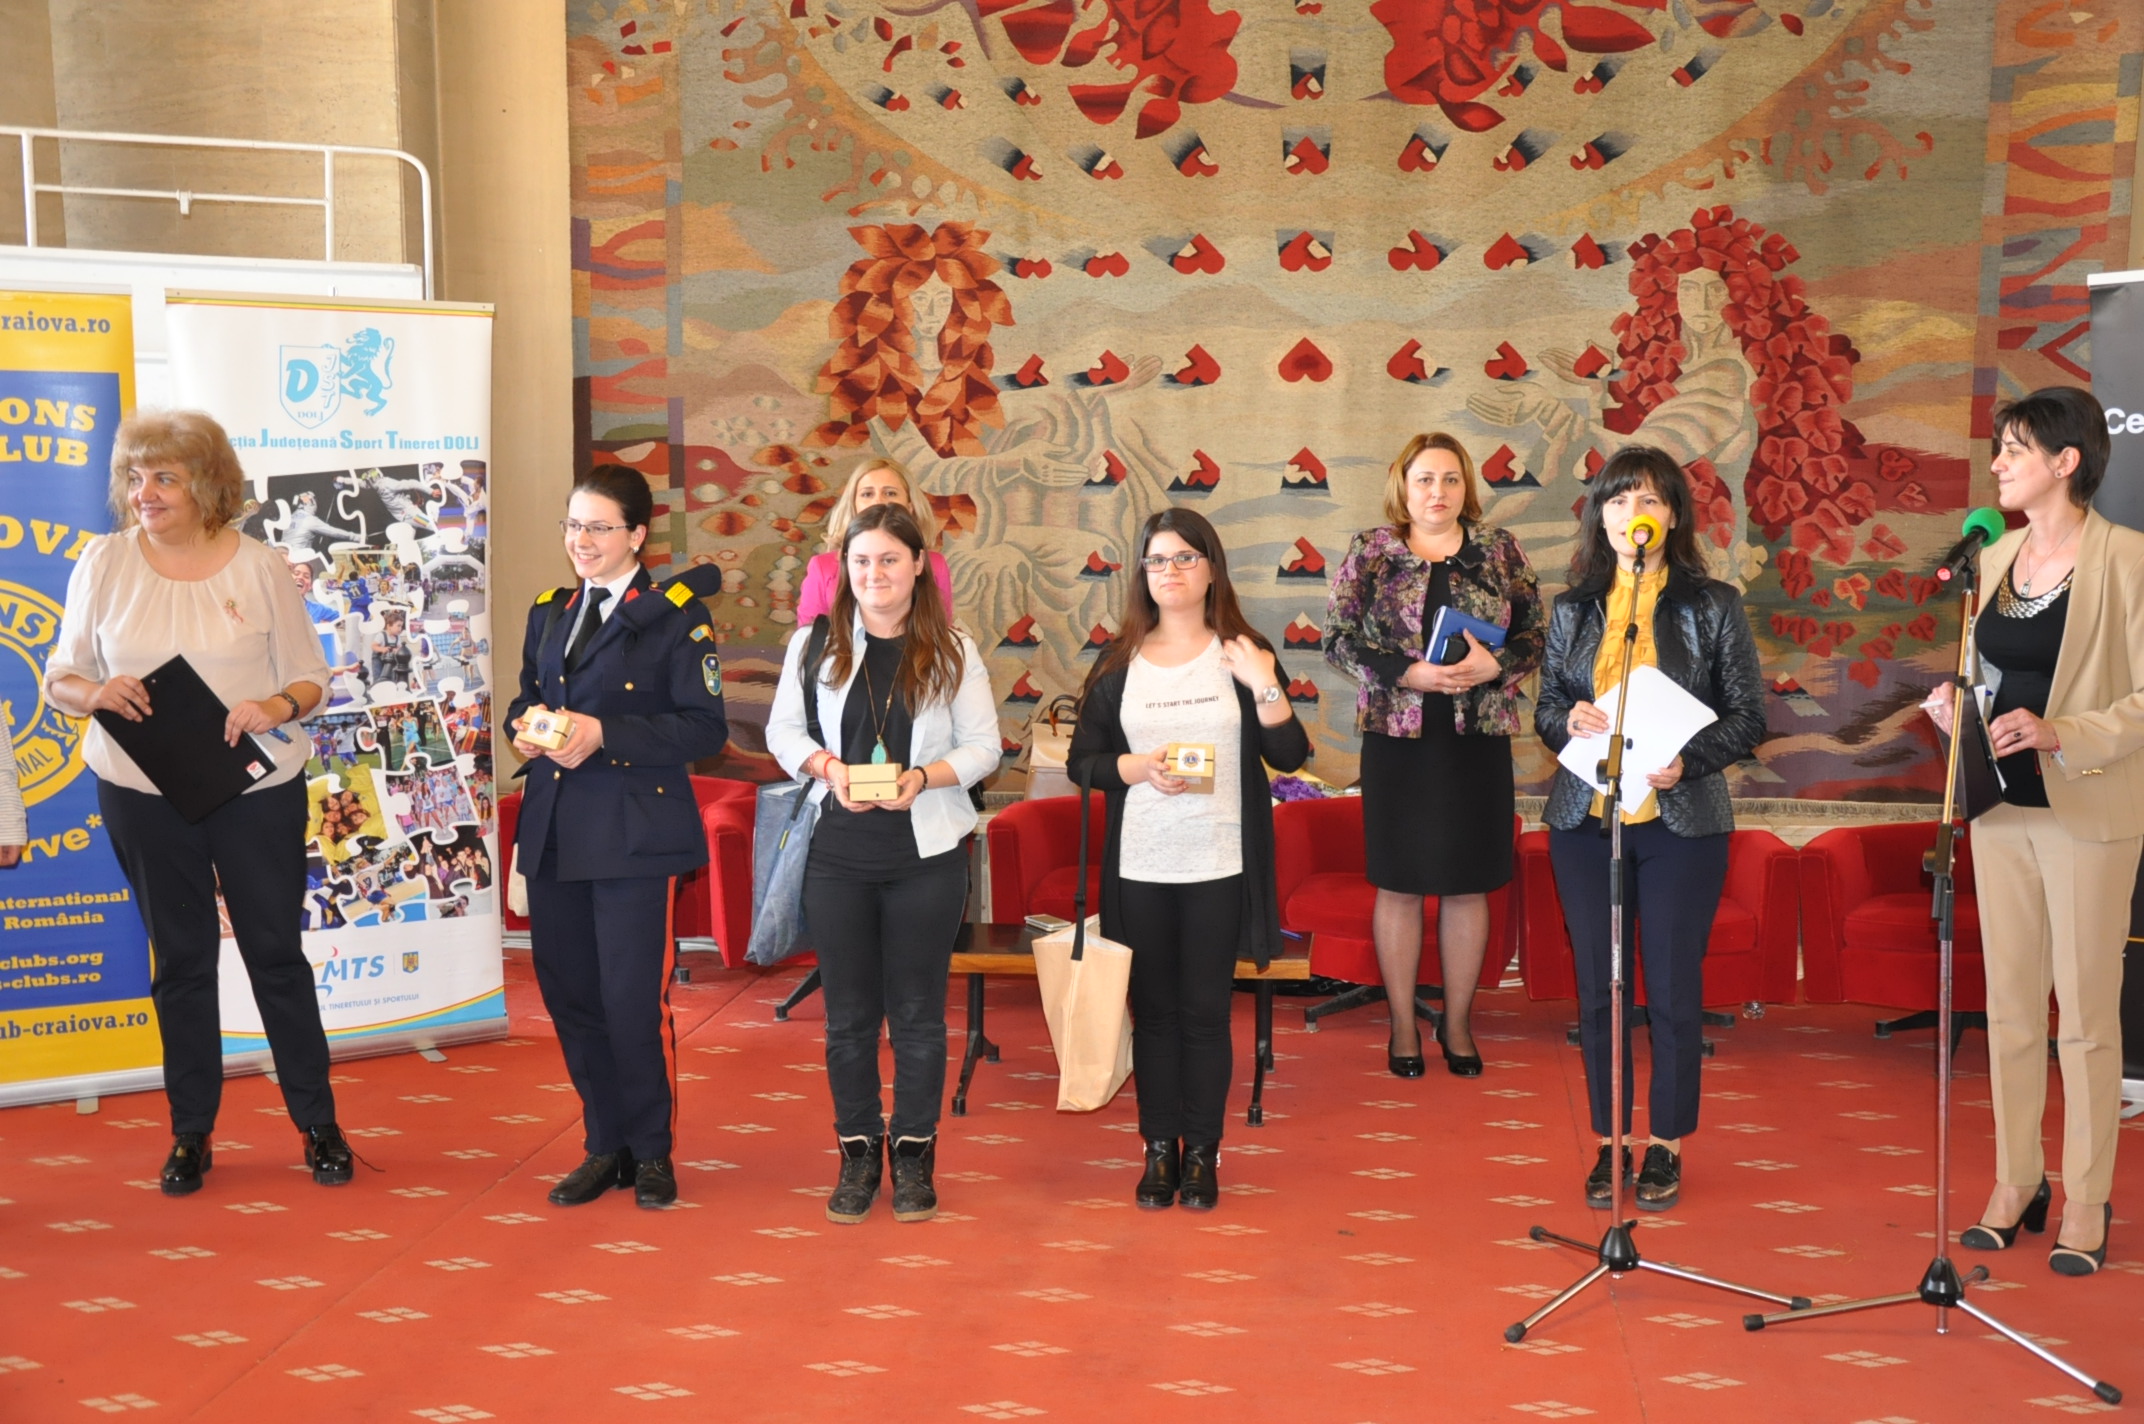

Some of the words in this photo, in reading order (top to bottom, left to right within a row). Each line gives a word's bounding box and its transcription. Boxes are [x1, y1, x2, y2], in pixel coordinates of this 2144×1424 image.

[2104, 407, 2144, 435] Ce
[340, 430, 383, 450] Sport
[385, 430, 440, 450] Tineret
[443, 436, 479, 450] DOLJ
[1194, 695, 1219, 705] JOURNEY
[4, 911, 104, 930] România
[321, 955, 385, 983] MTS
